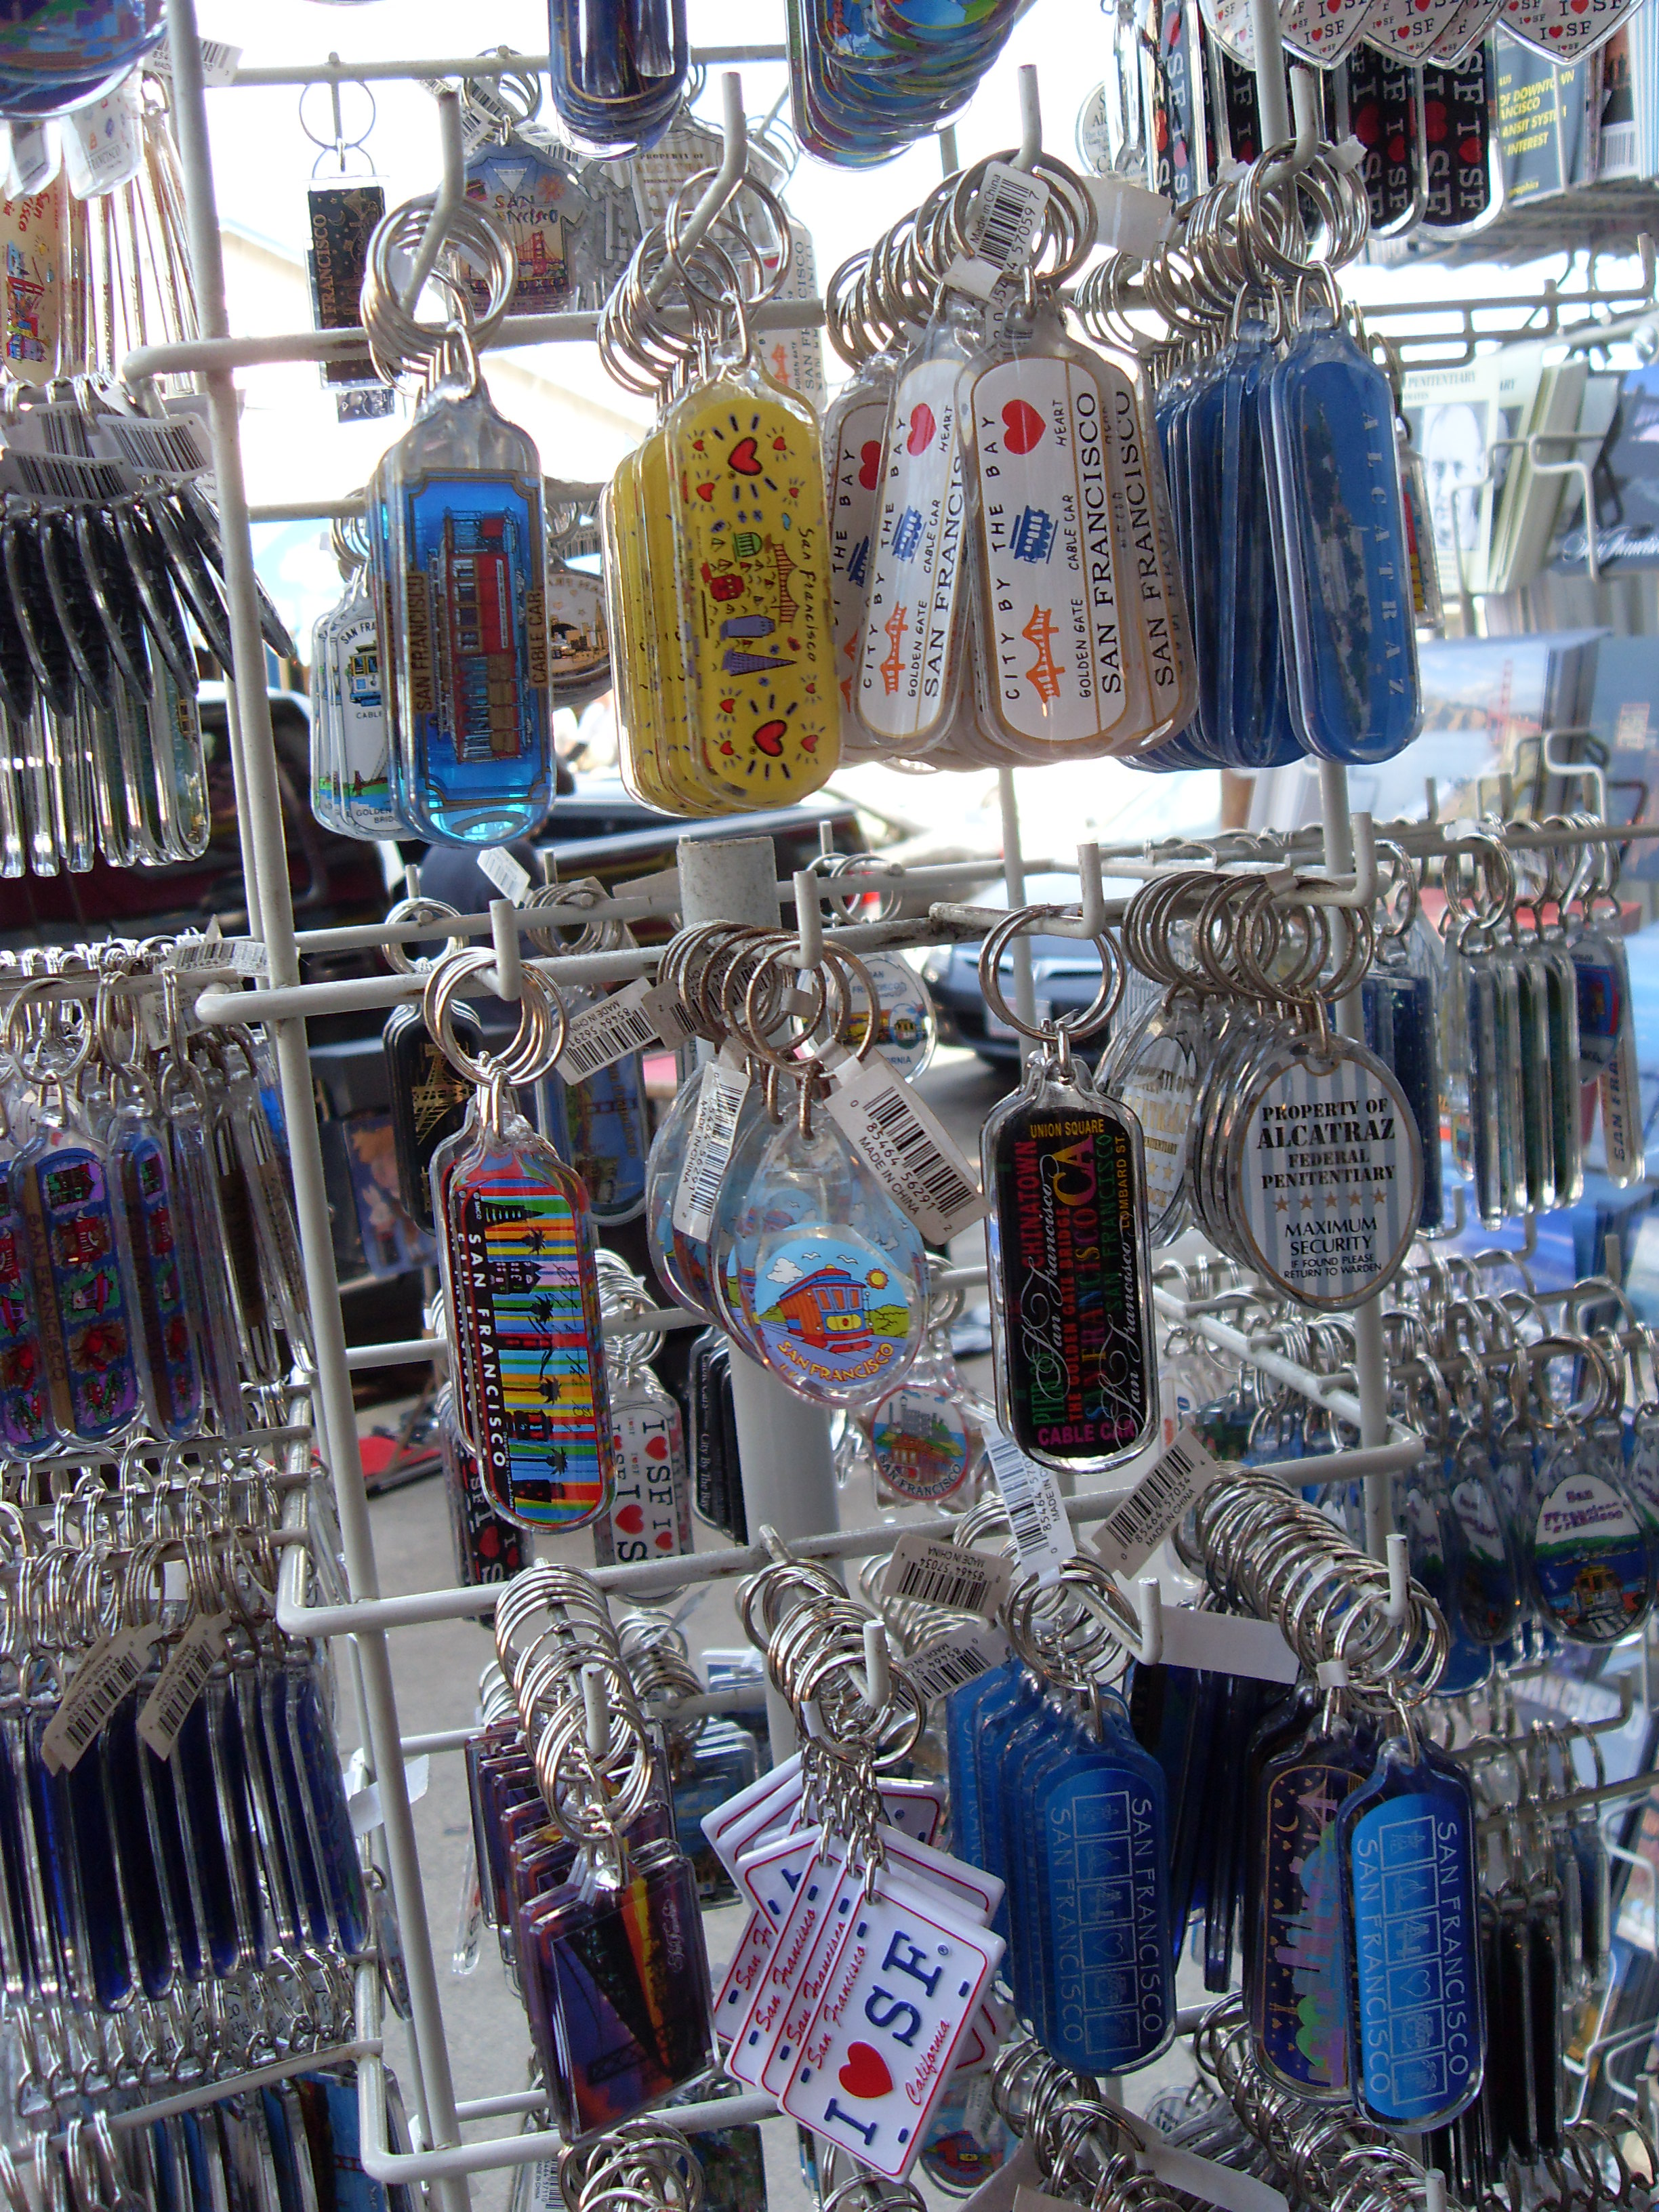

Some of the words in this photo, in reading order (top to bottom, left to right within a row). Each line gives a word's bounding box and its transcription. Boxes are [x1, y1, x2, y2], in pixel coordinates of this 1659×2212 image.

[1325, 20, 1345, 38] SF
[1412, 18, 1435, 37] SF
[1567, 20, 1592, 37] SF
[983, 173, 1002, 203] China
[1389, 166, 1408, 209] SF
[1427, 149, 1453, 216] SF
[1459, 168, 1485, 211] SF
[970, 220, 986, 244] Made
[982, 207, 989, 218] in
[1012, 207, 1037, 255] 57059
[313, 213, 337, 314] FRANCISCO
[804, 355, 813, 390] SAN
[939, 405, 953, 453] HEART
[1052, 399, 1067, 447] HEART
[981, 417, 1001, 478] BAY
[838, 449, 856, 507] BAY
[1077, 392, 1113, 607] FRANCISCO
[1116, 391, 1162, 602] FRANCISCO
[929, 499, 941, 527] CAR
[989, 504, 1006, 552] THE
[1063, 494, 1076, 523] CAR
[832, 531, 848, 573] THE
[863, 623, 879, 689] CITY
[874, 572, 885, 605] BY
[881, 502, 895, 548] THE
[890, 417, 906, 478] BAY
[923, 532, 937, 574] CABLE
[1064, 528, 1080, 571] CABLE
[1362, 410, 1406, 695] ALCATRAZ
[527, 592, 543, 626] CAR
[996, 578, 1014, 612] BY
[1071, 598, 1086, 633] GATE
[340, 627, 359, 644] SAN
[408, 573, 430, 674] FRANCISCO
[531, 633, 548, 684] CABLE
[907, 640, 922, 697] GOLDEN
[916, 600, 928, 636] GATE
[924, 627, 946, 697] SAN
[1001, 632, 1020, 700] CITY
[1076, 639, 1091, 698] GOLDEN
[1097, 623, 1122, 693] SAN
[1147, 617, 1174, 687] SAN
[415, 677, 434, 711] SAN
[596, 1000, 621, 1019] MADE
[600, 1008, 631, 1029] 85464
[568, 1026, 598, 1047] 56291
[1030, 1124, 1063, 1139] UNION
[1065, 1119, 1105, 1136] SQUARE
[1263, 1101, 1359, 1122] PROPERTY
[1366, 1098, 1388, 1113] OF
[1256, 1118, 1396, 1149] ALCATRAZ
[682, 1147, 699, 1184] CHINA
[859, 1136, 885, 1170] MADE
[880, 1170, 896, 1184] IN
[890, 1182, 921, 1215] CHINA
[865, 1122, 901, 1166] 85464
[900, 1171, 937, 1210] 56291
[1261, 1166, 1396, 1189] PENITENTIARY
[1288, 1149, 1371, 1168] FEDERAL
[1015, 1141, 1046, 1269] CHINATOWN
[1095, 1134, 1118, 1257] FRANCISCO
[1115, 1158, 1131, 1229] LOMBARD
[1056, 1207, 1074, 1269] BRIDGE
[1285, 1217, 1378, 1237] MAXIMUM
[1290, 1235, 1373, 1256] SECURITY
[468, 1233, 487, 1288] SAN
[1284, 1269, 1322, 1279] RETURN
[1325, 1267, 1338, 1276] TO
[1341, 1263, 1382, 1275] WARDEN
[1291, 1261, 1299, 1269] IF
[1303, 1257, 1340, 1268] FOUND
[1342, 1254, 1374, 1265] PLEASE
[1059, 1276, 1076, 1316] GATE
[777, 1339, 808, 1370] SAN
[809, 1343, 895, 1382] FRANCISCO
[1063, 1322, 1081, 1387] GOLDEN
[476, 1307, 506, 1467] FRANCISCO
[1067, 1393, 1083, 1422] THE
[700, 1433, 710, 1454] City
[1037, 1425, 1095, 1447] CABLE
[1099, 1419, 1135, 1441] CAR
[701, 1457, 711, 1469] By
[701, 1473, 711, 1490] The
[879, 1453, 899, 1480] SAN
[899, 1463, 962, 1496] FRANCISCO
[1042, 1478, 1052, 1490] IN
[646, 1465, 675, 1506] SF
[700, 1494, 711, 1511] Bay
[1046, 1490, 1061, 1522] MADE
[1035, 1492, 1052, 1532] 85464
[1134, 1512, 1163, 1544] 85464
[1164, 1478, 1191, 1509] 57034
[1145, 1522, 1169, 1548] MADE
[1165, 1513, 1176, 1524] IN
[1172, 1489, 1196, 1515] CHINA
[919, 1558, 951, 1574] 57034
[928, 1546, 953, 1560] CHINA
[956, 1566, 985, 1581] 85464
[923, 1643, 950, 1661] MADE
[928, 1647, 962, 1668] 85464
[1050, 1806, 1074, 1868] SAN
[1130, 1797, 1155, 1858] SAN
[1357, 1837, 1380, 1903] SAN
[1436, 1821, 1461, 1885] SAN
[735, 1950, 762, 1990] San
[754, 1991, 781, 2033] San
[773, 1908, 817, 1990] Francisco
[1053, 1877, 1085, 2044] FRANCISCO
[1134, 1867, 1164, 2033] FRANCISCO
[785, 2006, 811, 2046] San
[802, 1920, 847, 2001] Francisco
[1440, 1898, 1470, 2077] FRANCISCO
[805, 2032, 833, 2070] San
[823, 1944, 868, 2027] Francisco
[1361, 1915, 1393, 2095] FRANCISCO
[823, 2097, 878, 2147] I
[864, 1929, 943, 2049] SF
[905, 2019, 951, 2108] California
